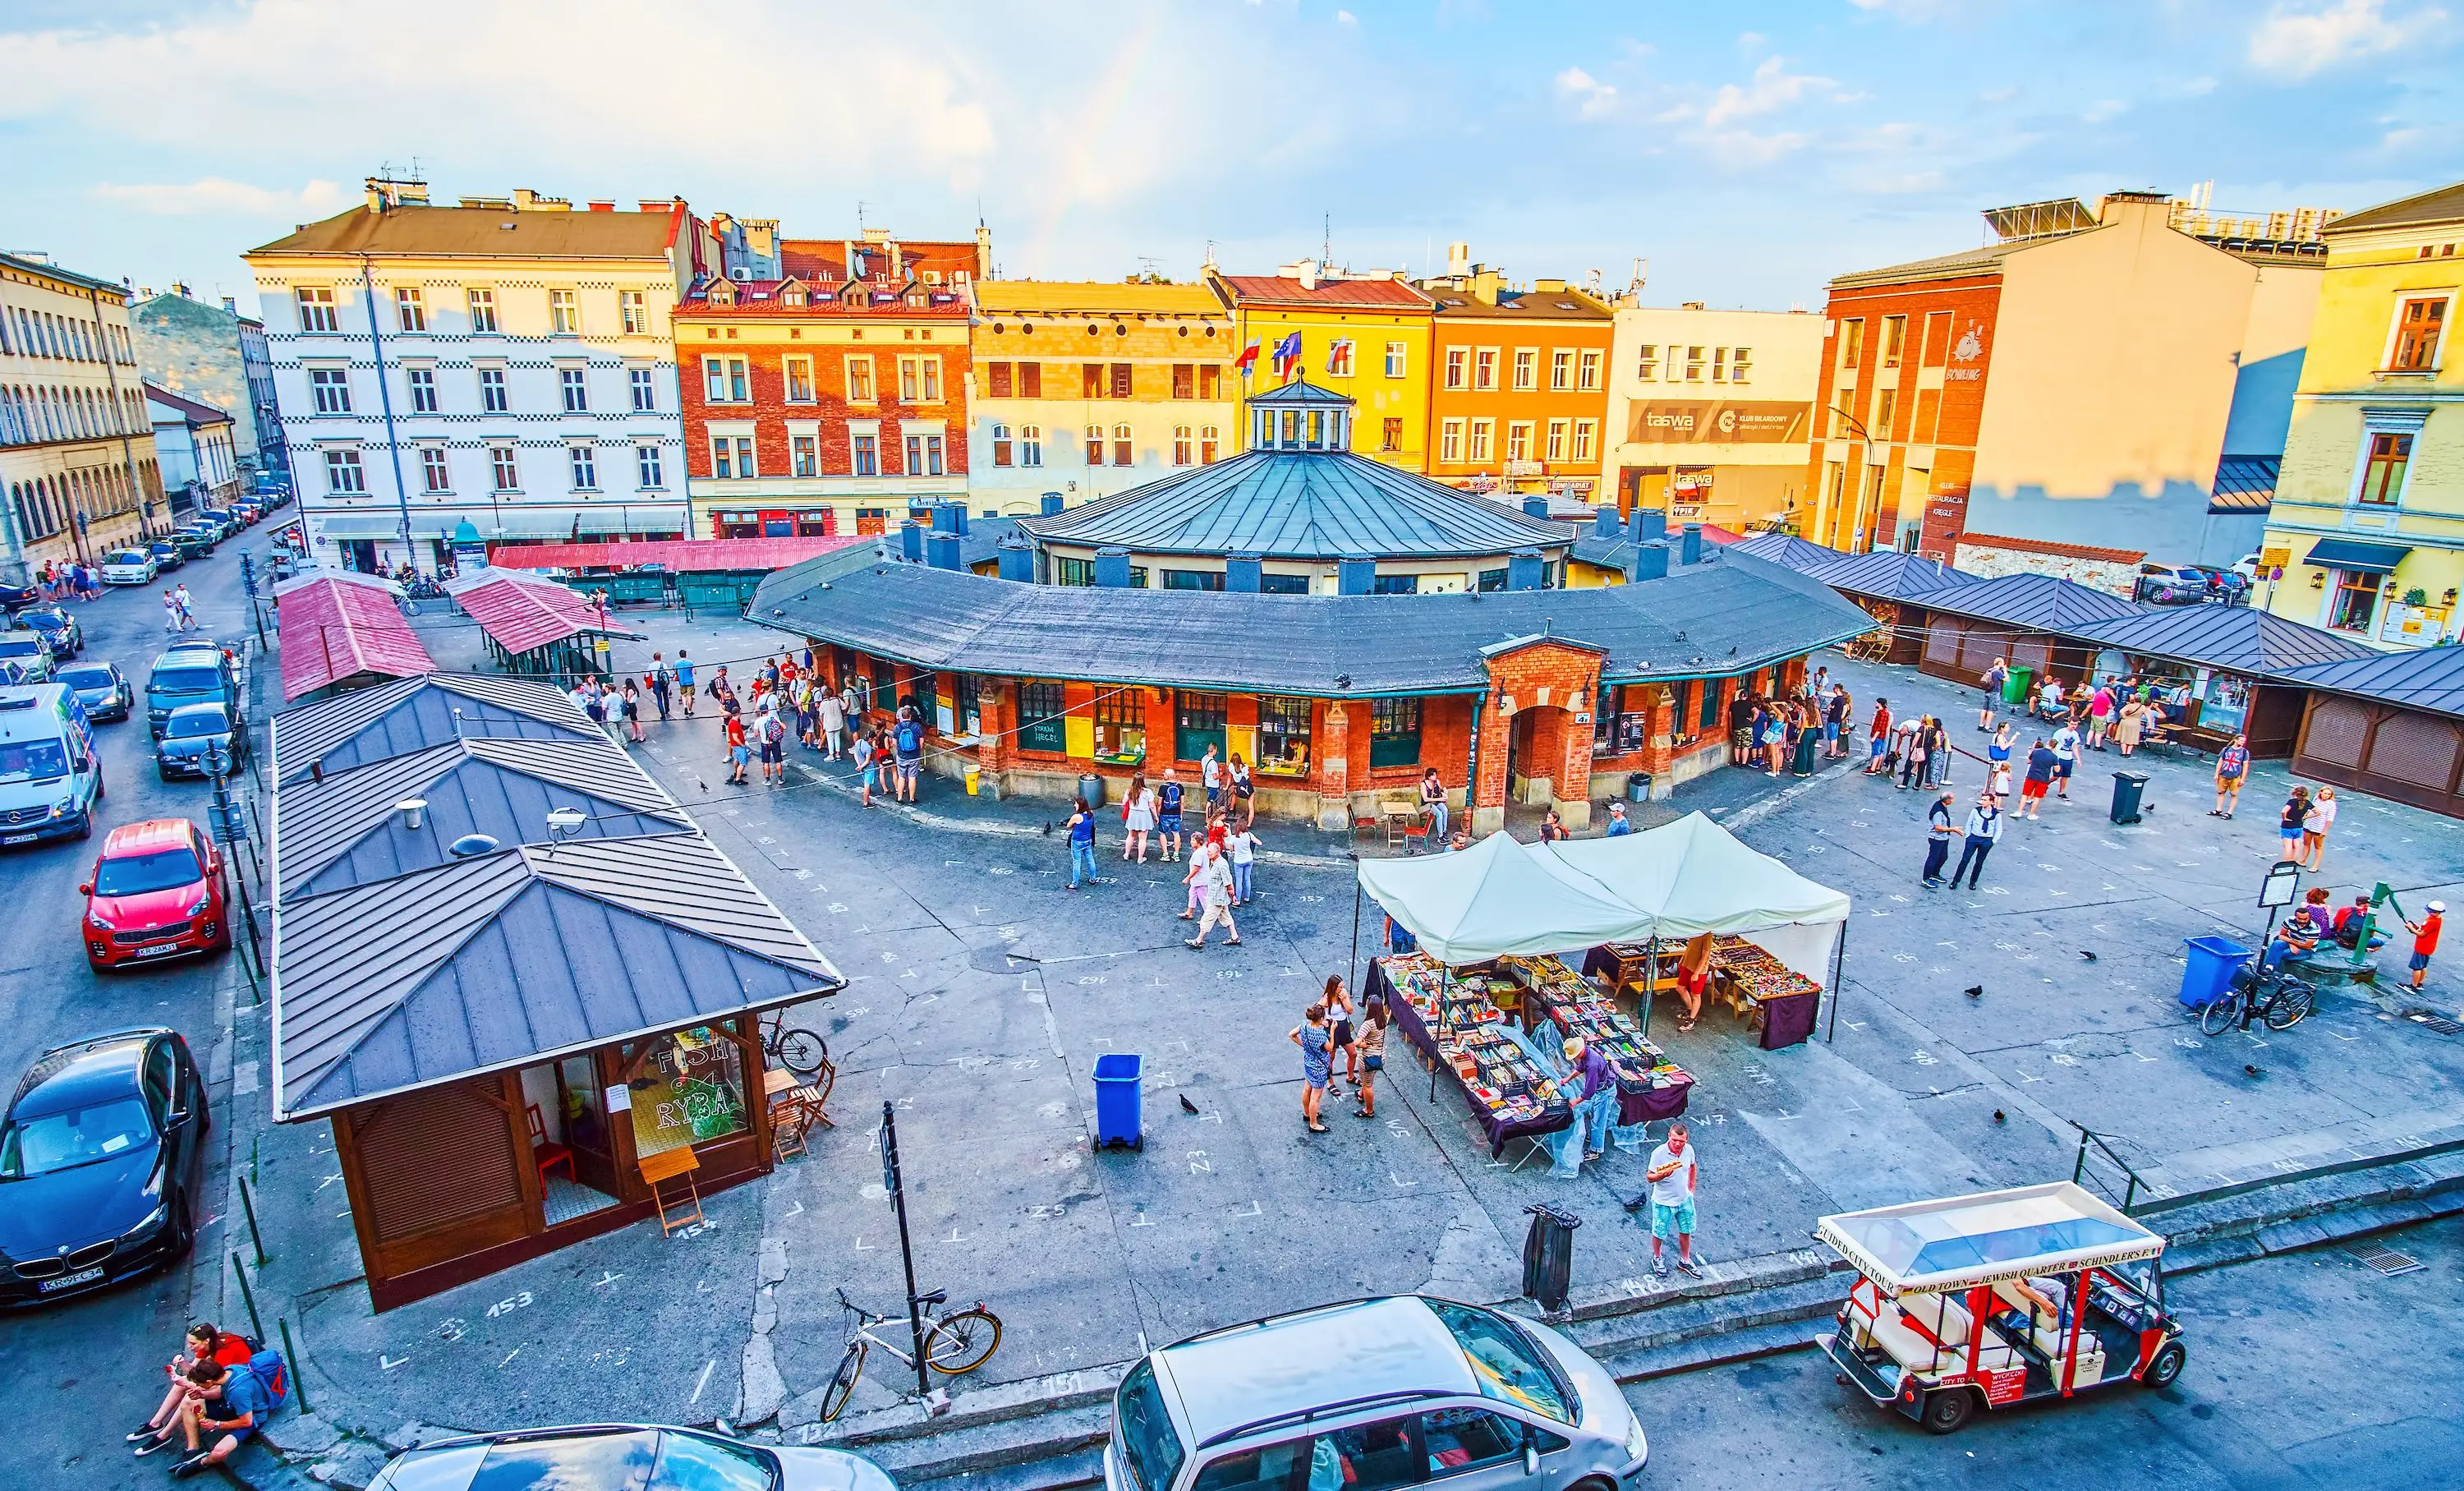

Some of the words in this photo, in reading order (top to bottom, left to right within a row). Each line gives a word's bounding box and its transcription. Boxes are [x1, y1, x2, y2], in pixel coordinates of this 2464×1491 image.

[1946, 368, 1980, 381] BOWLING
[1079, 976, 1109, 985] 162
[846, 1006, 871, 1018] 165
[658, 1037, 729, 1073] FISH
[656, 1087, 729, 1129] RYBA
[1818, 1225, 1848, 1254] GUIDED
[1849, 1250, 1871, 1272] CITY
[1870, 1267, 1894, 1294] TOUR
[2080, 1249, 2140, 1268] SCHINDLER'S
[2141, 1248, 2149, 1257] F.
[1979, 1271, 2017, 1284] JEWISH
[2019, 1262, 2066, 1280] QUARTER
[46, 1279, 63, 1289] KR
[1914, 1283, 1936, 1294] OLD
[1938, 1278, 1970, 1291] TOWN
[486, 1291, 534, 1317] 153
